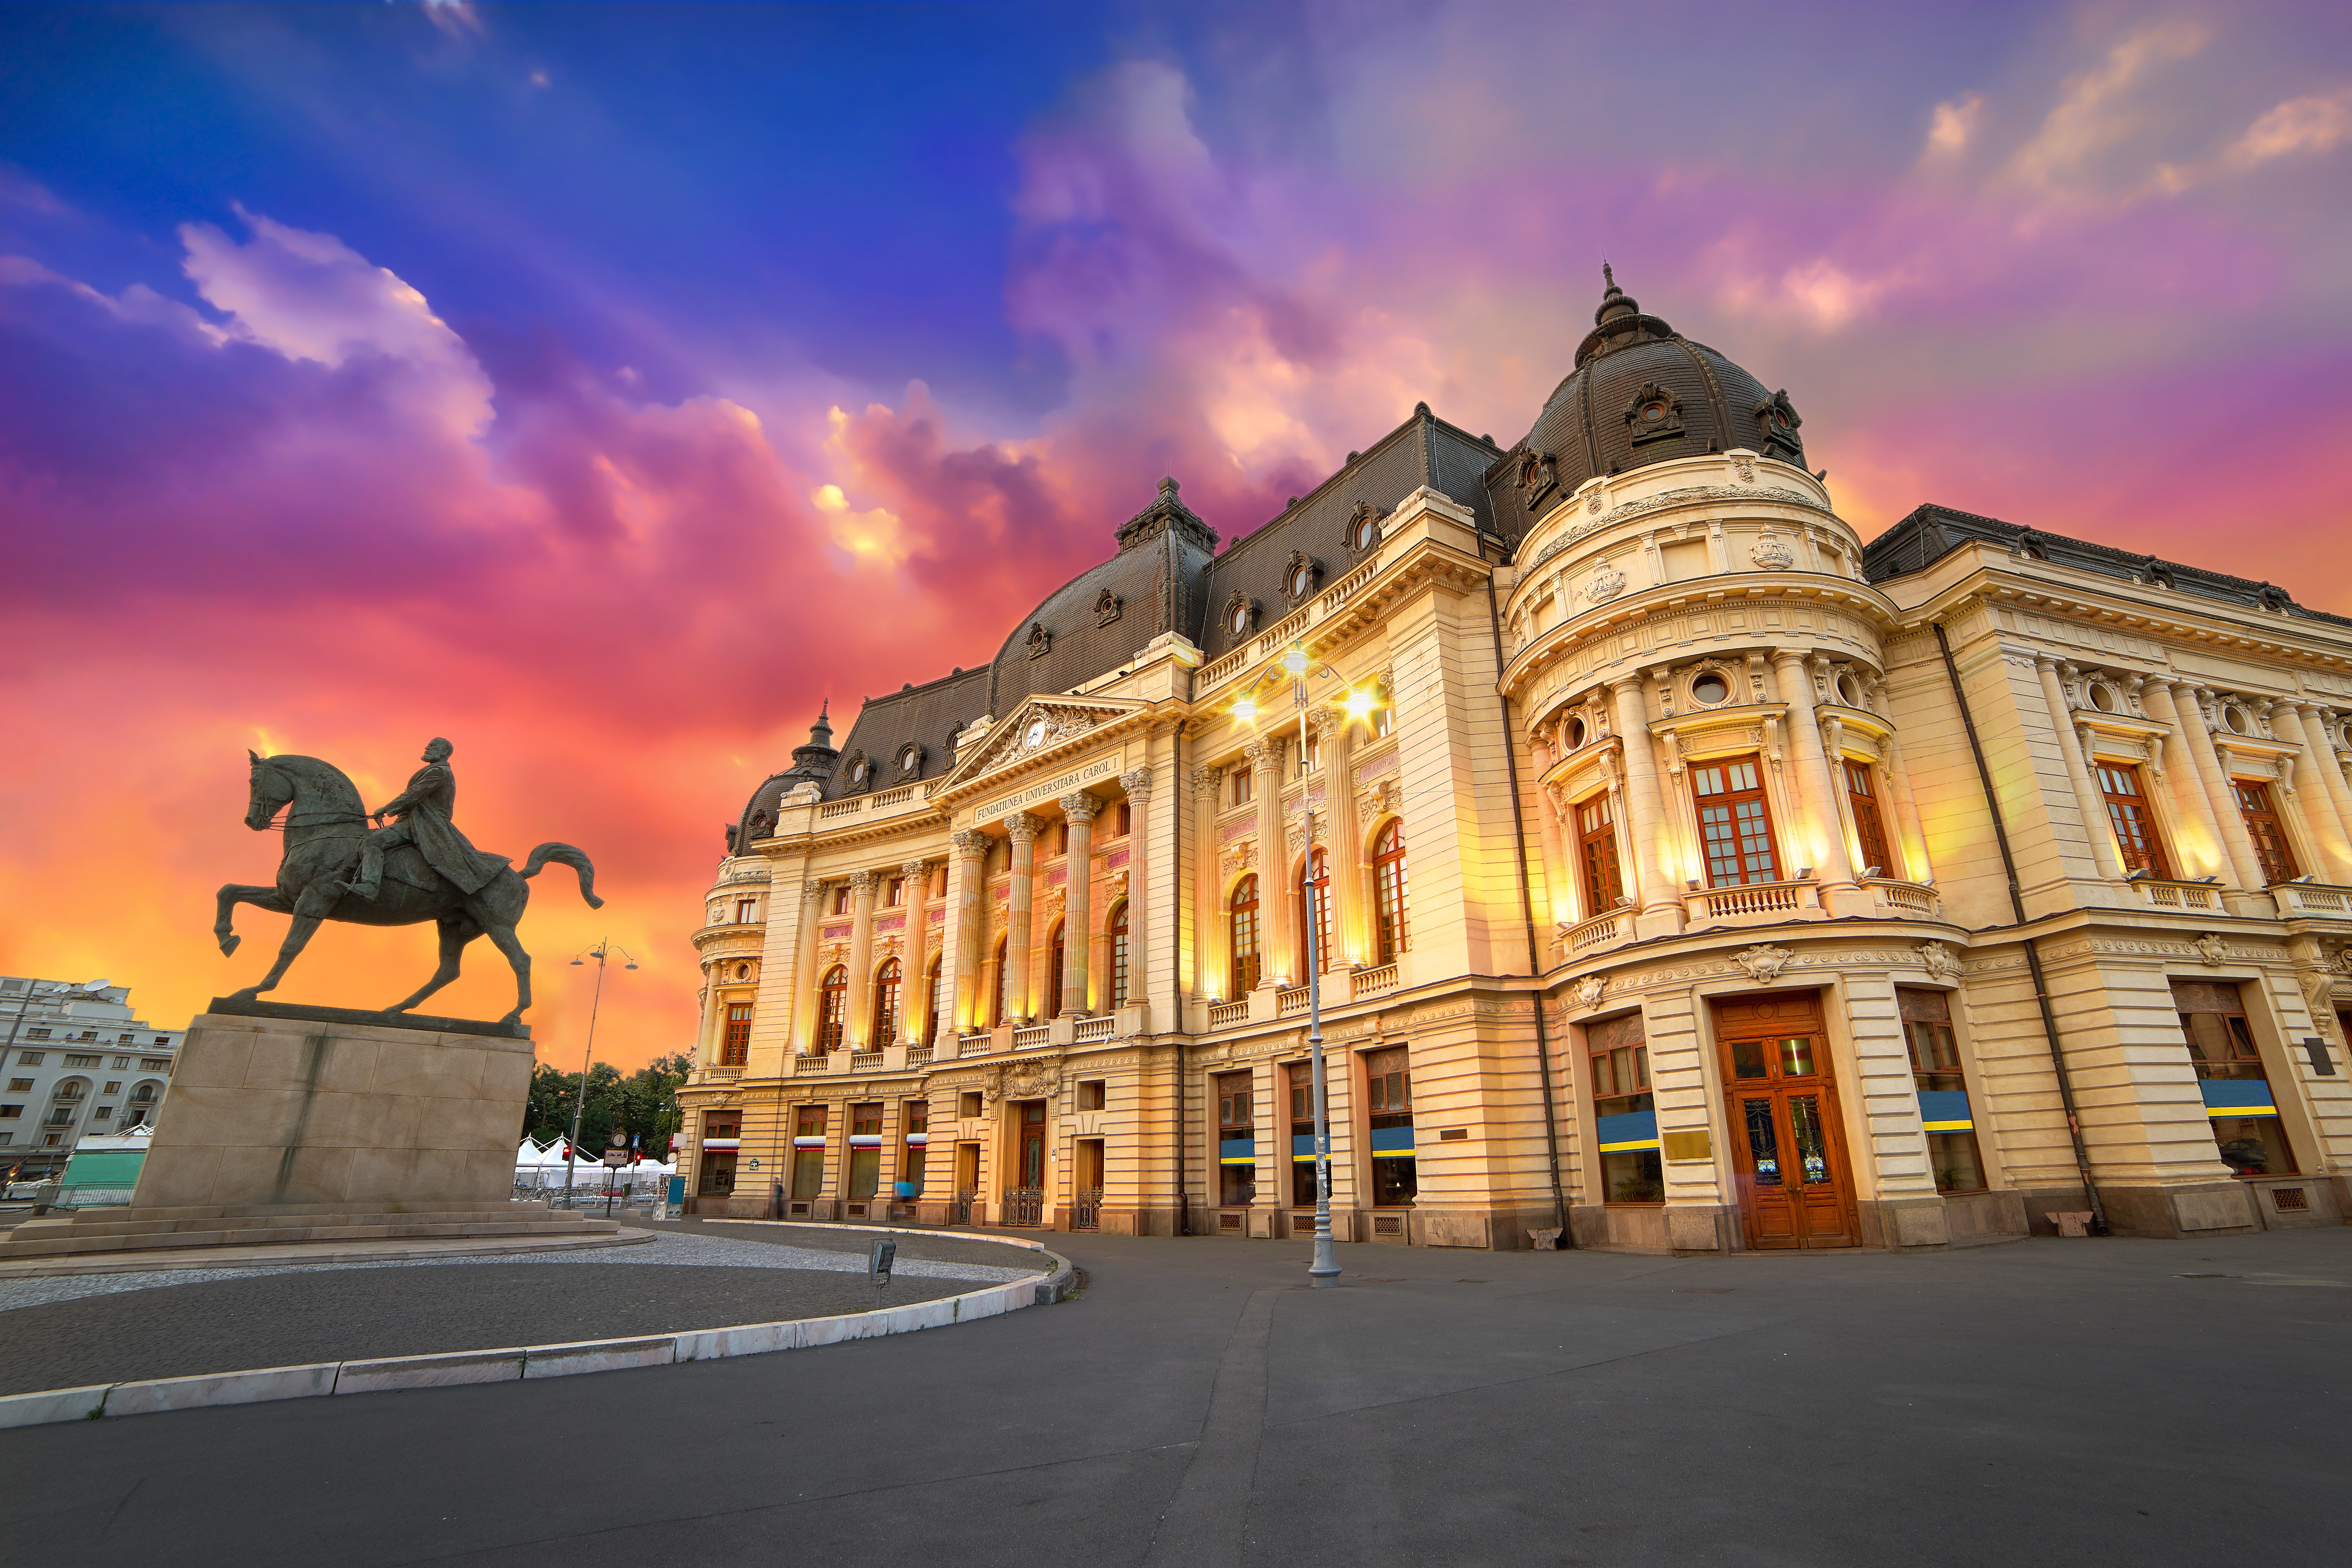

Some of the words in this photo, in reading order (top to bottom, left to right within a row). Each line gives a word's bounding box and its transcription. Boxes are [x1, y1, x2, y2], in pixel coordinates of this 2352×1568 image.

[978, 795, 1023, 819] FUNDATIUNEA
[1026, 773, 1079, 801] UNIVERSITARA
[1084, 761, 1110, 779] CAROL
[1114, 758, 1117, 769] I
